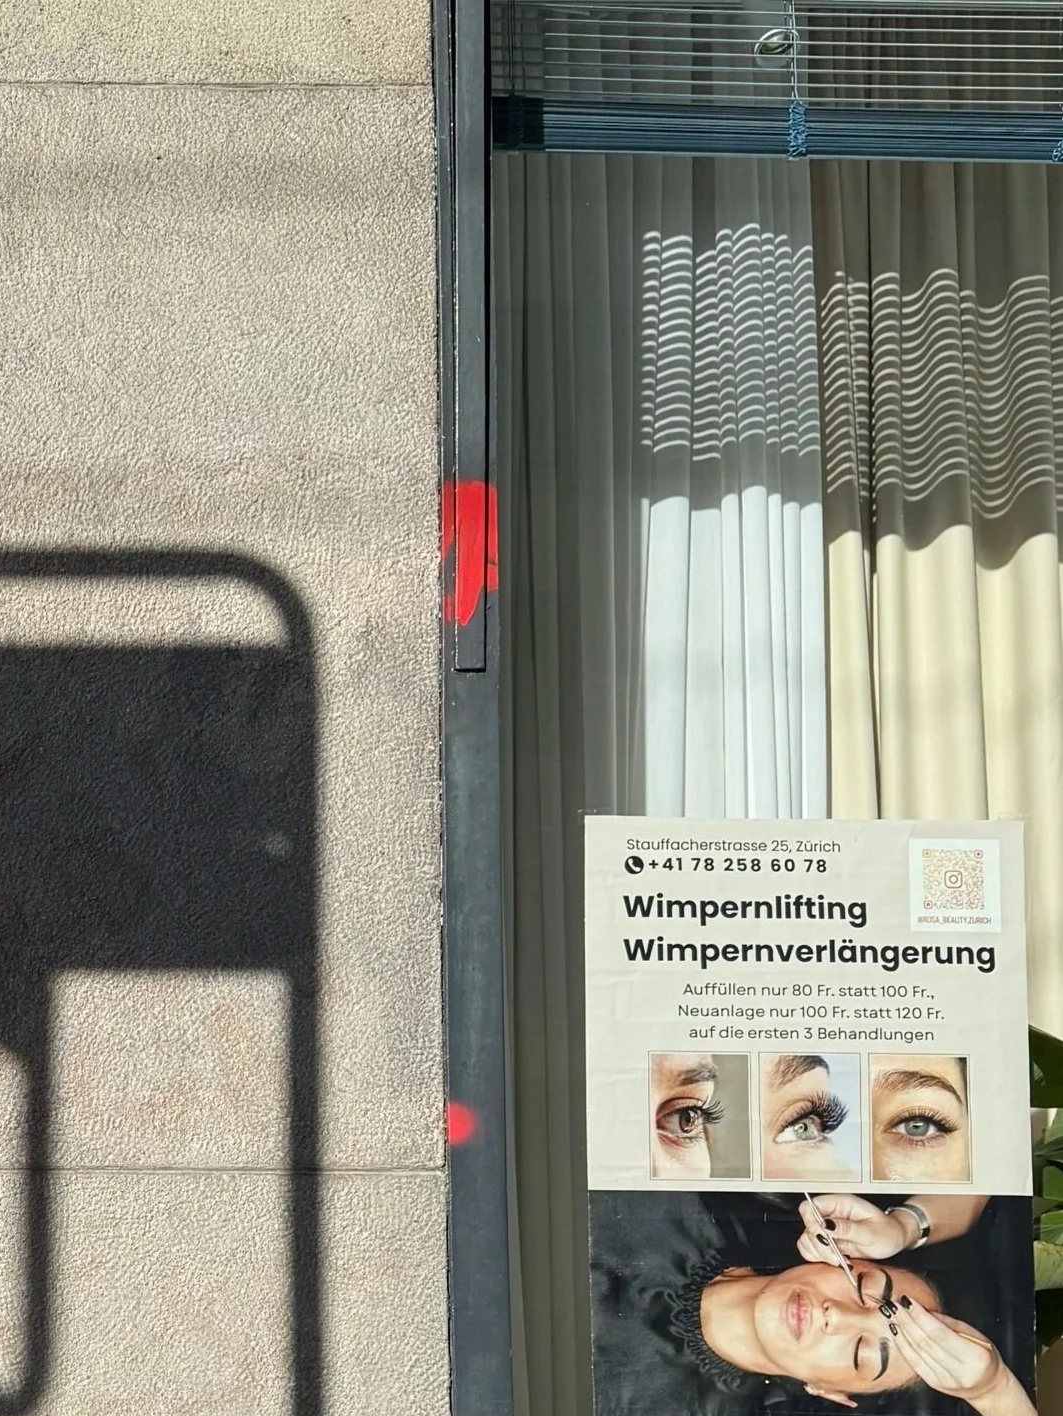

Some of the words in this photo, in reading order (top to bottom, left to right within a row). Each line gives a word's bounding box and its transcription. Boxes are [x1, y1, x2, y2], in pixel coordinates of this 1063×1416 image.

[626, 838, 768, 852] Stauffacherstrasse
[771, 839, 792, 854] 25,
[796, 839, 841, 853] Zürich
[648, 857, 683, 872] +41
[690, 857, 715, 872] 78
[723, 857, 762, 873] 258
[770, 858, 796, 873] 60
[803, 858, 827, 873] 78
[623, 893, 867, 928] Wimpernlifting
[623, 936, 996, 974] Wimpernverlängerung
[683, 982, 756, 997] Auffüllen
[761, 986, 788, 997] nur
[792, 984, 813, 997] 80
[817, 984, 835, 997] Fr.
[838, 986, 877, 997] statt
[880, 985, 908, 998] 100
[912, 985, 935, 1000] Fr.,
[678, 1004, 765, 1020] Neuanlage
[769, 1007, 797, 1018] nur
[799, 1005, 828, 1019] 100
[832, 1006, 850, 1019] Fr.
[854, 1007, 892, 1019] statt
[895, 1006, 922, 1020] 120
[927, 1007, 945, 1020] Fr.
[689, 1025, 716, 1039] auf
[718, 1025, 744, 1039] die
[747, 1027, 799, 1040] ersten
[804, 1027, 813, 1040] 3
[817, 1027, 935, 1043] Behandlungen
